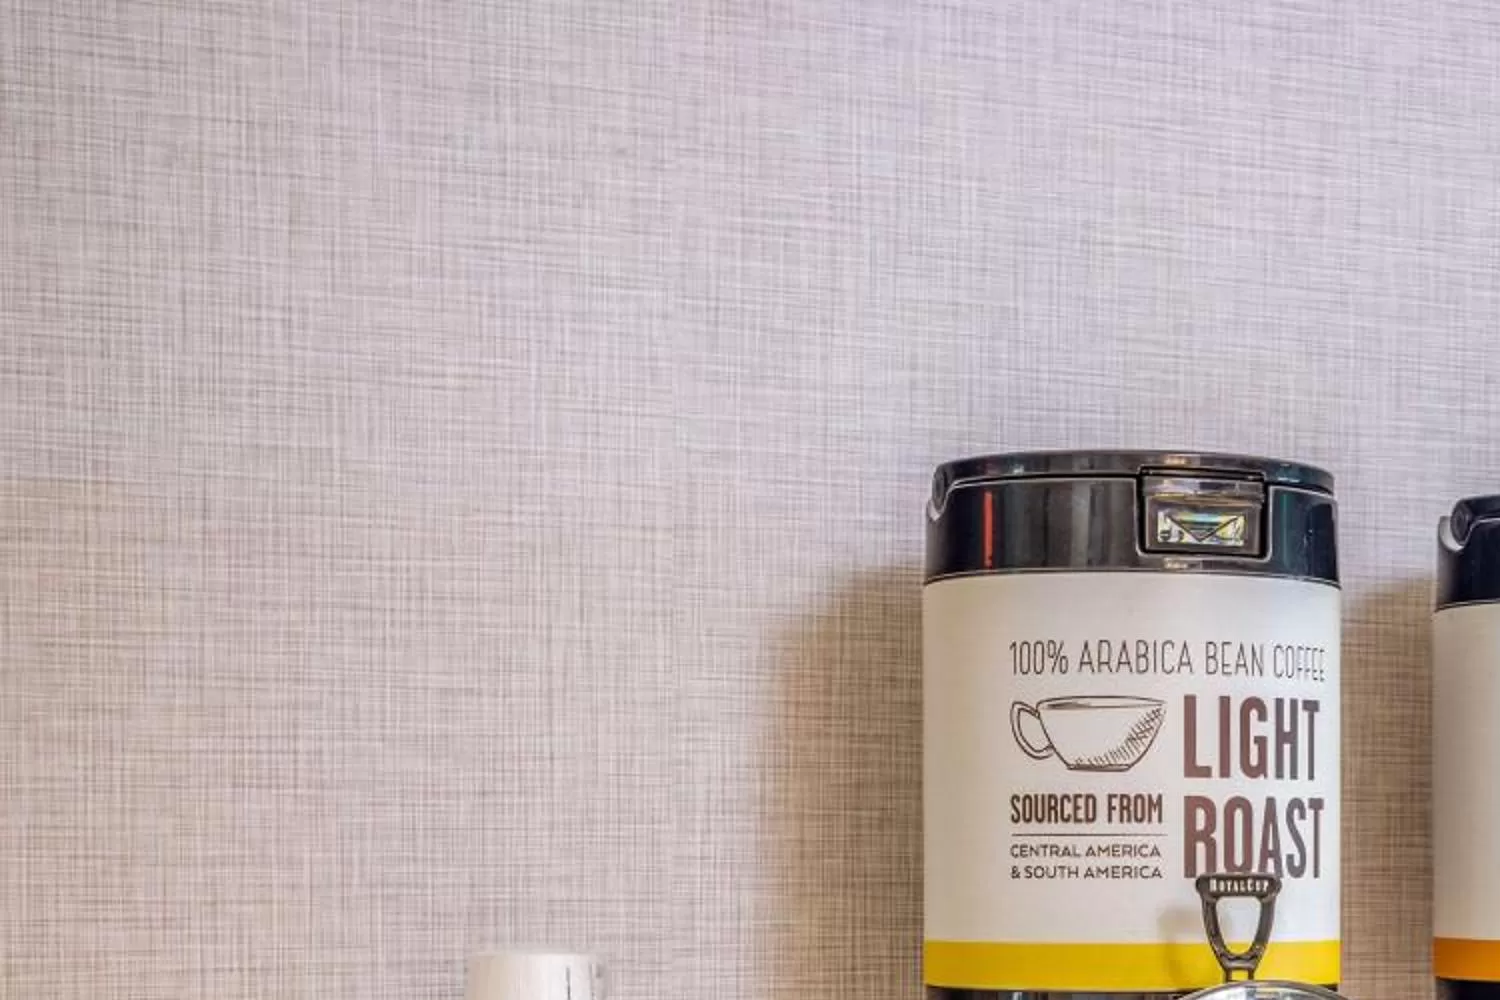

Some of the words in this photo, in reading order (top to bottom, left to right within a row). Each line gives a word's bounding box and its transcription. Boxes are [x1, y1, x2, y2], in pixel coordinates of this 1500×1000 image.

[1009, 640, 1069, 676] 100%
[1078, 640, 1194, 675] ARABICA
[1204, 642, 1264, 677] BEAN
[1273, 644, 1326, 682] COFFEE
[1183, 694, 1320, 781] LIGHT
[1010, 793, 1098, 825] SOURCED
[1107, 794, 1163, 824] FROM
[1010, 844, 1081, 859] CENTRAL
[1085, 844, 1161, 859] AMERICA
[1183, 795, 1325, 879] ROAST
[1011, 866, 1020, 879] &
[1024, 865, 1080, 879] SOUTH
[1083, 865, 1163, 879] AMERICA
